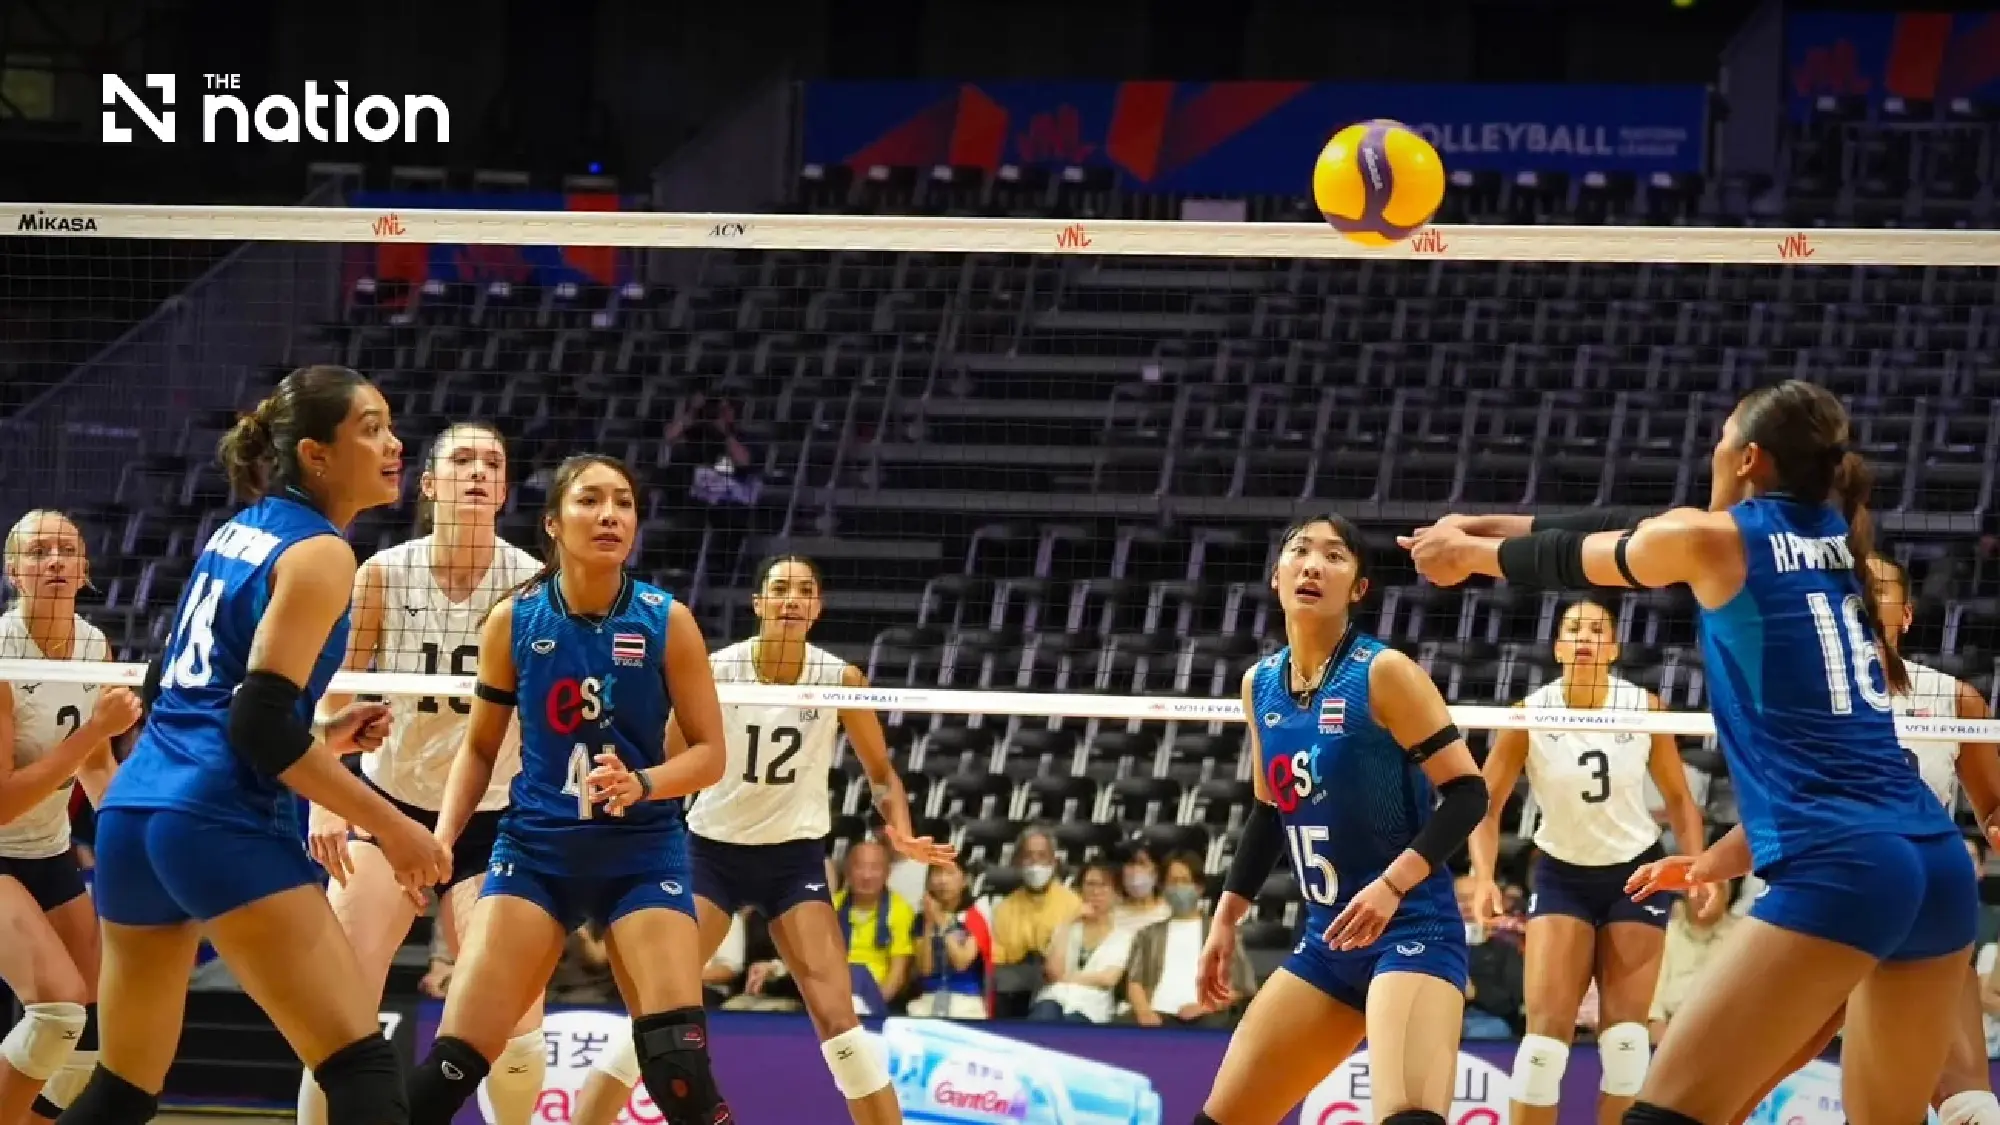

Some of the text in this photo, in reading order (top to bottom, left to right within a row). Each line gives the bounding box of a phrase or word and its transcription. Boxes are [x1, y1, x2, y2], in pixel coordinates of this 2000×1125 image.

[1417, 122, 1613, 156] OLLEYBALL
[372, 212, 406, 236] VNL
[1057, 223, 1092, 248] VNL
[1412, 229, 1449, 253] VNL
[1778, 232, 1815, 258] VNL
[1806, 592, 1891, 714] 16
[546, 672, 619, 736] est
[742, 725, 803, 785] 12
[1267, 744, 1323, 814] est
[1578, 749, 1611, 803] 3
[1286, 825, 1339, 906] 15
